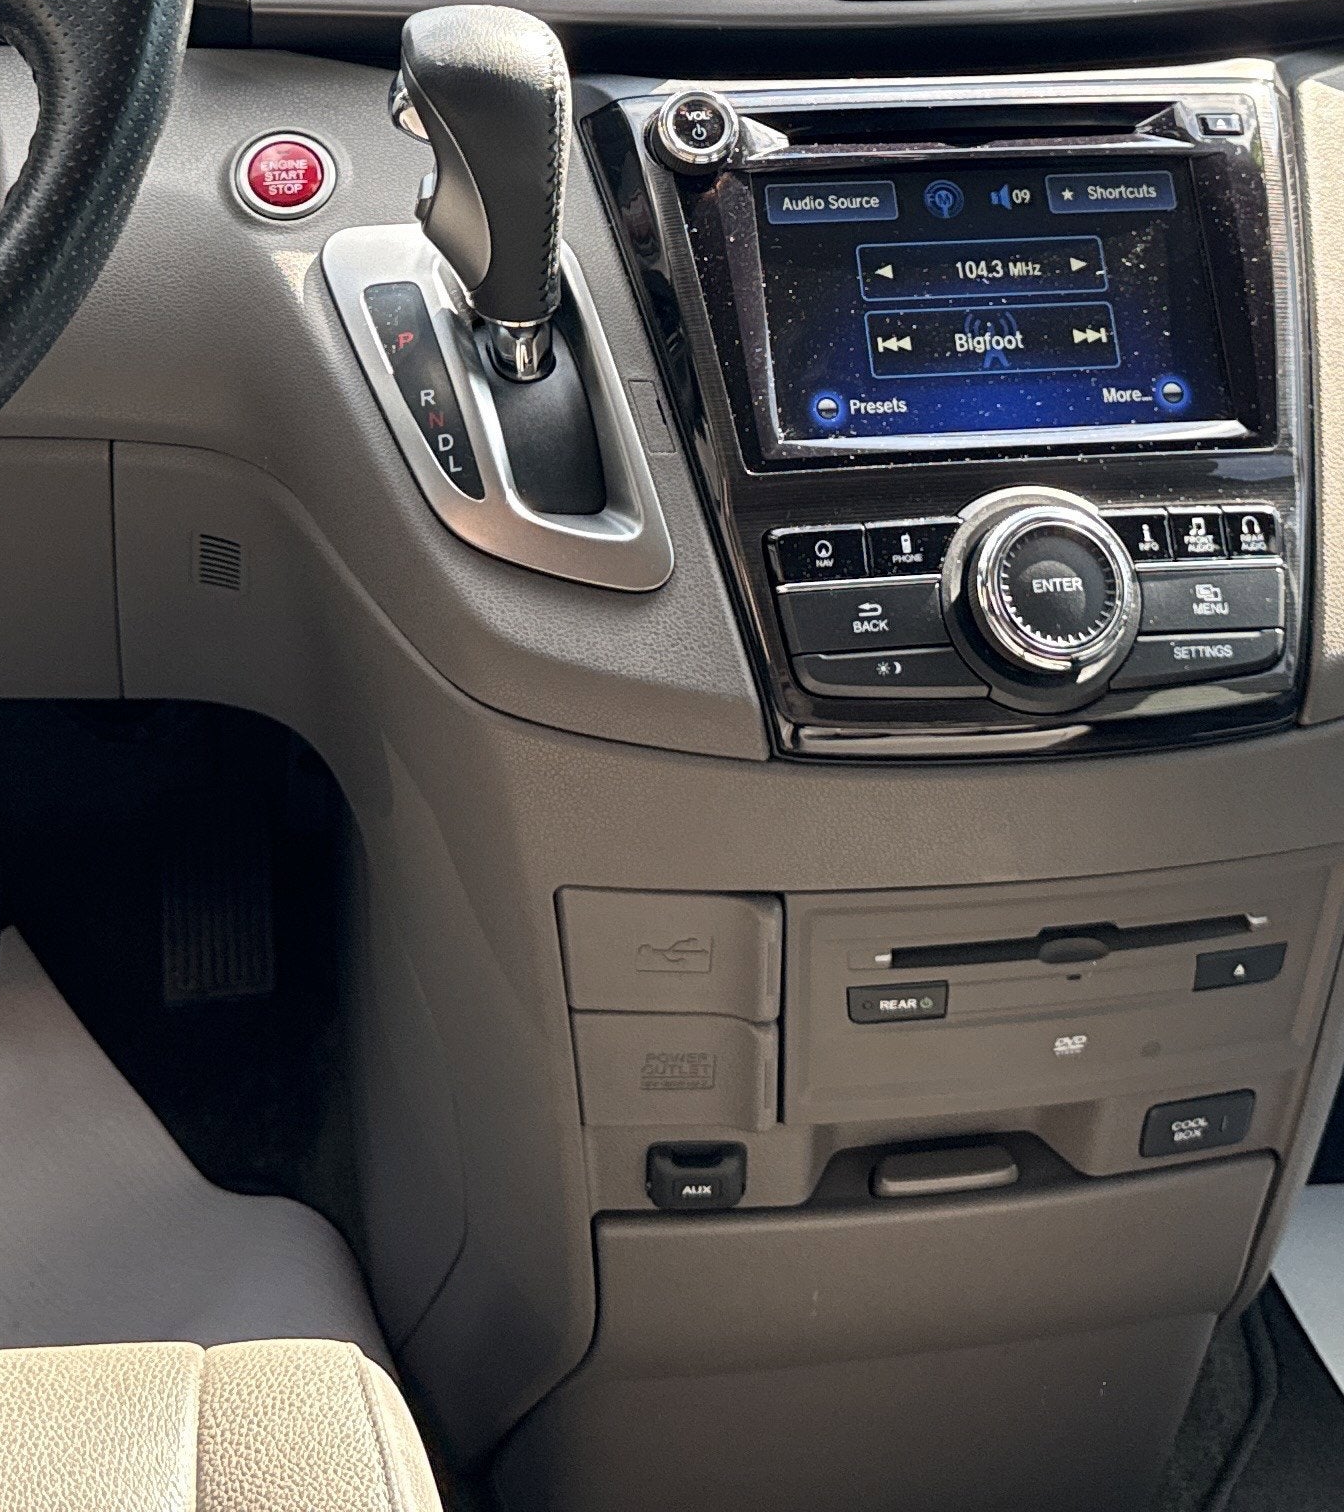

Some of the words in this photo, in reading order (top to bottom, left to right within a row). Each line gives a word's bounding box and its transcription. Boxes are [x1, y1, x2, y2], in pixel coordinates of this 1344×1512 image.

[686, 110, 710, 121] VOL
[260, 159, 308, 172] ENGINE
[264, 170, 306, 182] START
[269, 183, 303, 195] STOP
[1012, 189, 1031, 204] 09
[1087, 183, 1157, 201] Shortcuts
[782, 196, 825, 212] Audio
[828, 195, 880, 210] Source
[955, 259, 1004, 280] 104.3
[1008, 261, 1042, 276] MHz
[397, 330, 414, 350] P
[955, 331, 1024, 354] Bigfoot
[420, 389, 436, 407] R
[849, 397, 908, 415] Presets
[428, 411, 445, 429] N
[438, 433, 454, 452] D
[449, 455, 462, 473] L
[815, 558, 834, 568] NAV
[892, 552, 924, 564] PHONE
[1031, 576, 1083, 594] ENTER
[1192, 602, 1229, 616] MENU
[852, 619, 890, 634] BACK
[1173, 644, 1234, 660] SETTINGS
[879, 998, 918, 1011] REAR
[645, 1052, 707, 1064] POWER
[640, 1063, 712, 1076] OUTLET
[1171, 1117, 1208, 1131] COOL
[1173, 1128, 1201, 1142] BOX
[682, 1185, 712, 1196] AUX
